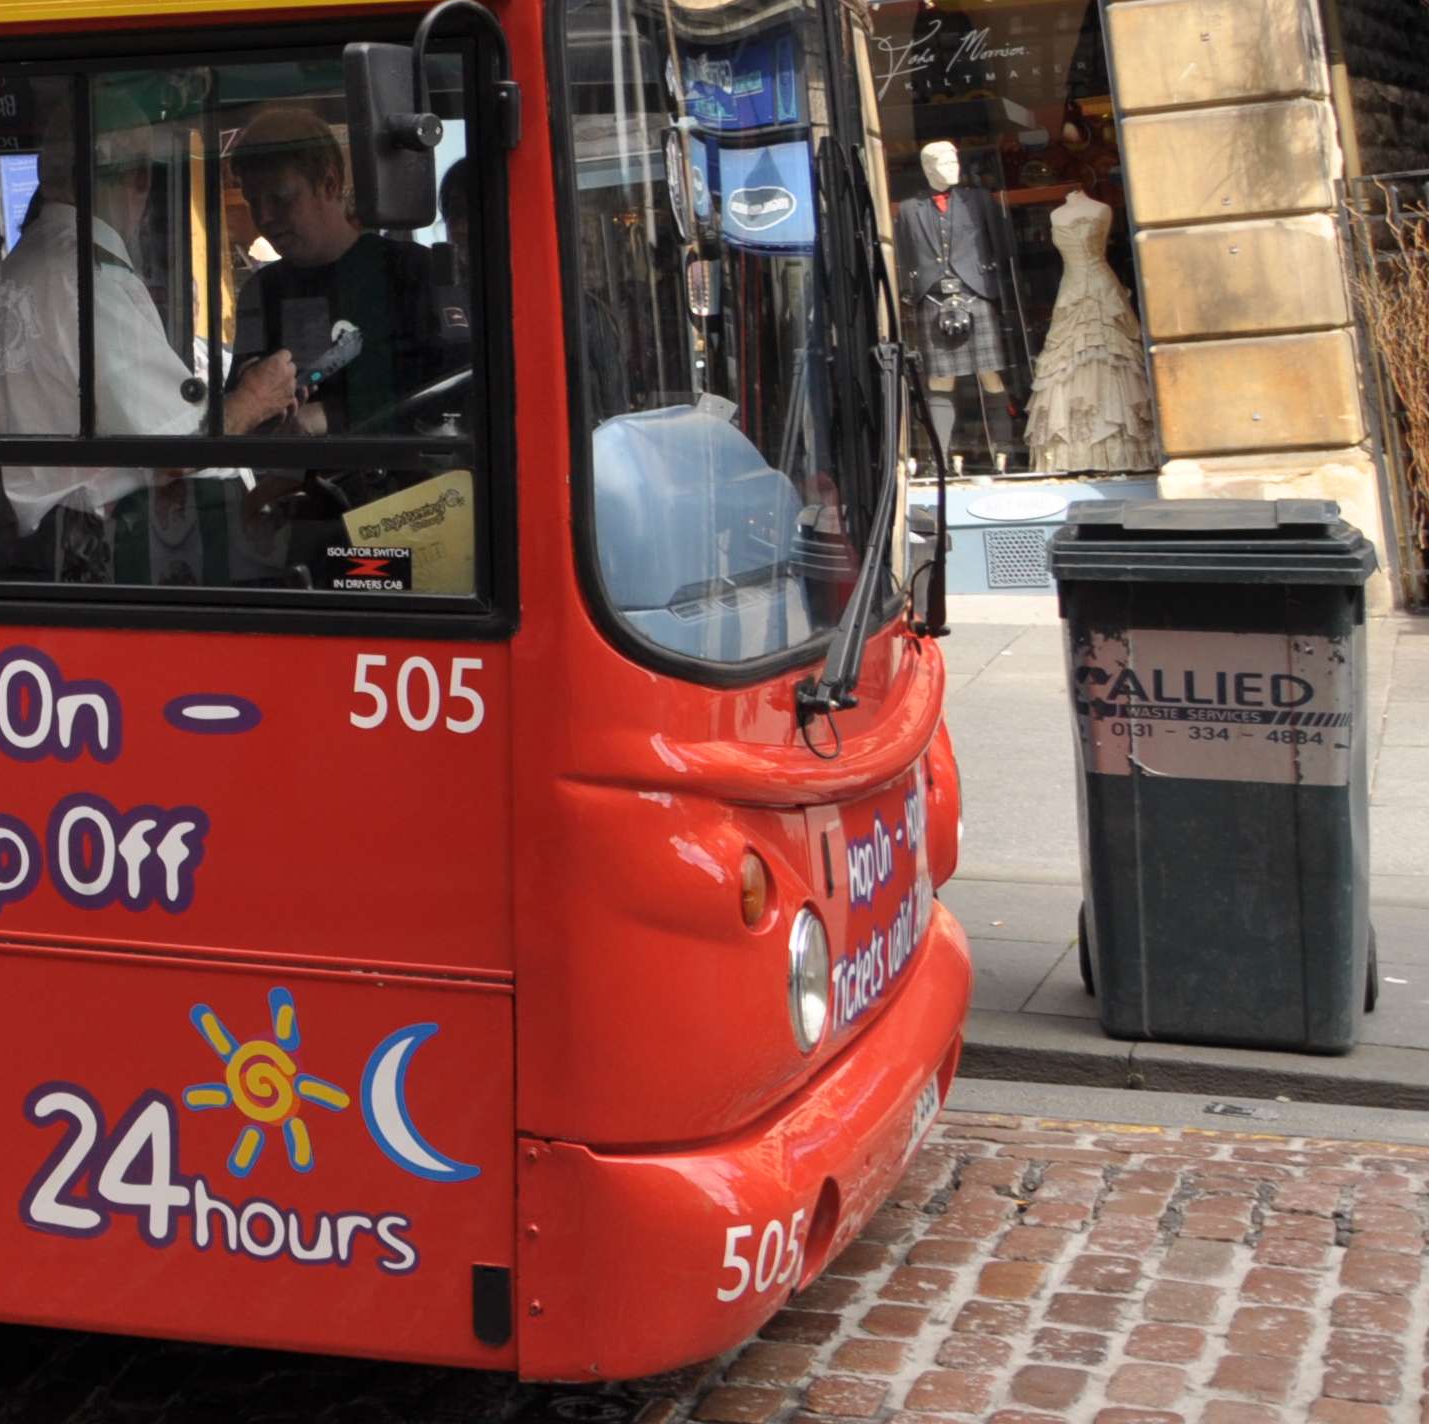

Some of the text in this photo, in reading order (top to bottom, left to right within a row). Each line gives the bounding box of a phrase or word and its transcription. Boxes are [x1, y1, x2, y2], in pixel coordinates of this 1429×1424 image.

[327, 547, 410, 558] ISOLATOR SWITCH
[333, 579, 404, 590] IN DRIVERS CAB
[348, 654, 486, 736] 505
[1106, 669, 1314, 708] ALLIED
[1126, 706, 1262, 724] WASTE SERVICES
[1111, 723, 1153, 738] 0131
[1189, 726, 1230, 741] 334
[56, 802, 199, 903] Off
[847, 842, 875, 904] Hop
[873, 818, 892, 882] On
[831, 929, 884, 1031] Tickets
[27, 1092, 418, 1273] 24 hours
[715, 1208, 806, 1303] 505
